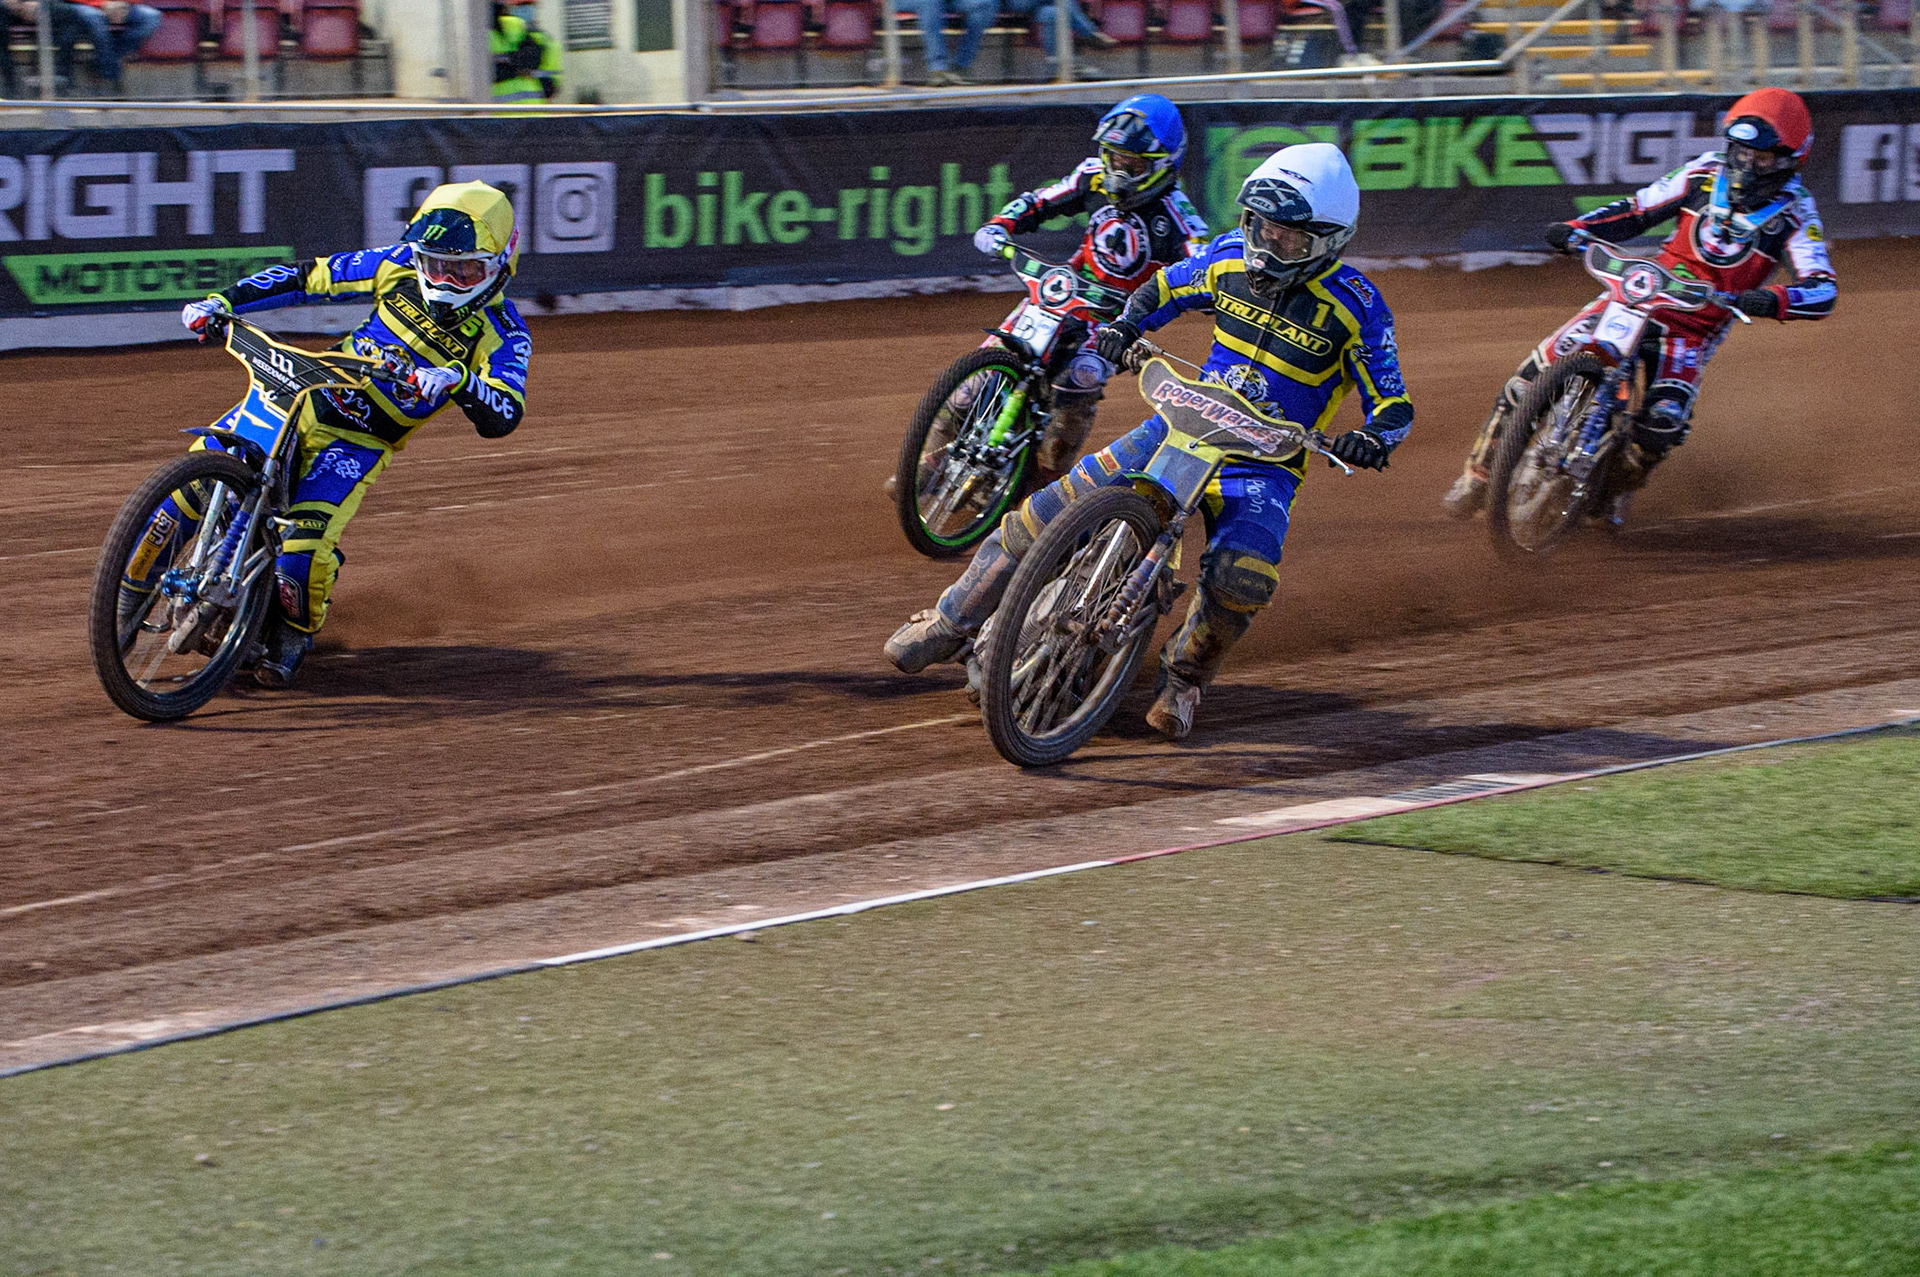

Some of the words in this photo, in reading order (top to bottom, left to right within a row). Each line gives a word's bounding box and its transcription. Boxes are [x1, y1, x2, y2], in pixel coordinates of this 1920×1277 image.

[644, 162, 1090, 256] bike-right
[35, 257, 284, 297] MOTORB
[1220, 297, 1259, 321] TRU
[1256, 315, 1327, 352] PLANT
[1311, 302, 1331, 329] 1
[419, 319, 464, 354] PLANT
[152, 513, 175, 547] JCB
